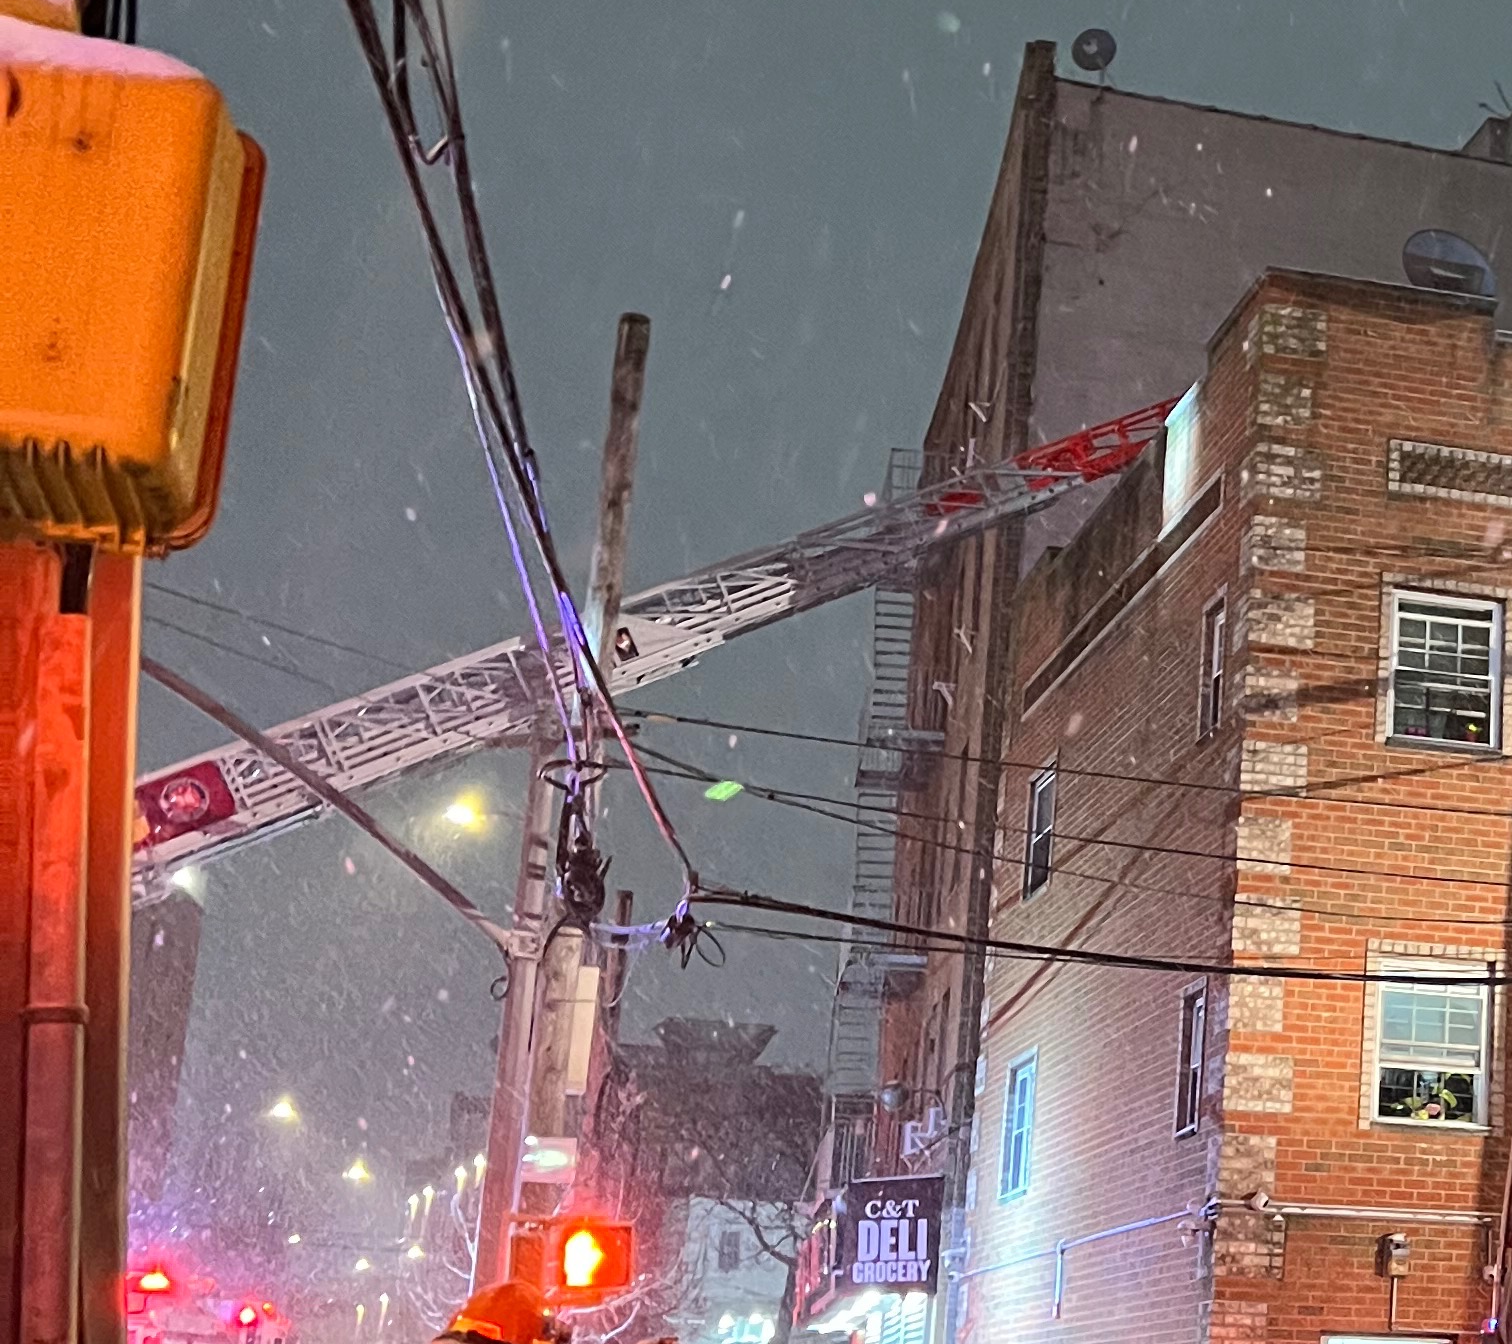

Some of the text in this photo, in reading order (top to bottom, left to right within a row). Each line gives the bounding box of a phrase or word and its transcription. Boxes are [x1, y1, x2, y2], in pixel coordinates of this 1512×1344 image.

[865, 1199, 919, 1218] C&T
[858, 1218, 927, 1261] DELI
[852, 1260, 931, 1283] GROCERY
